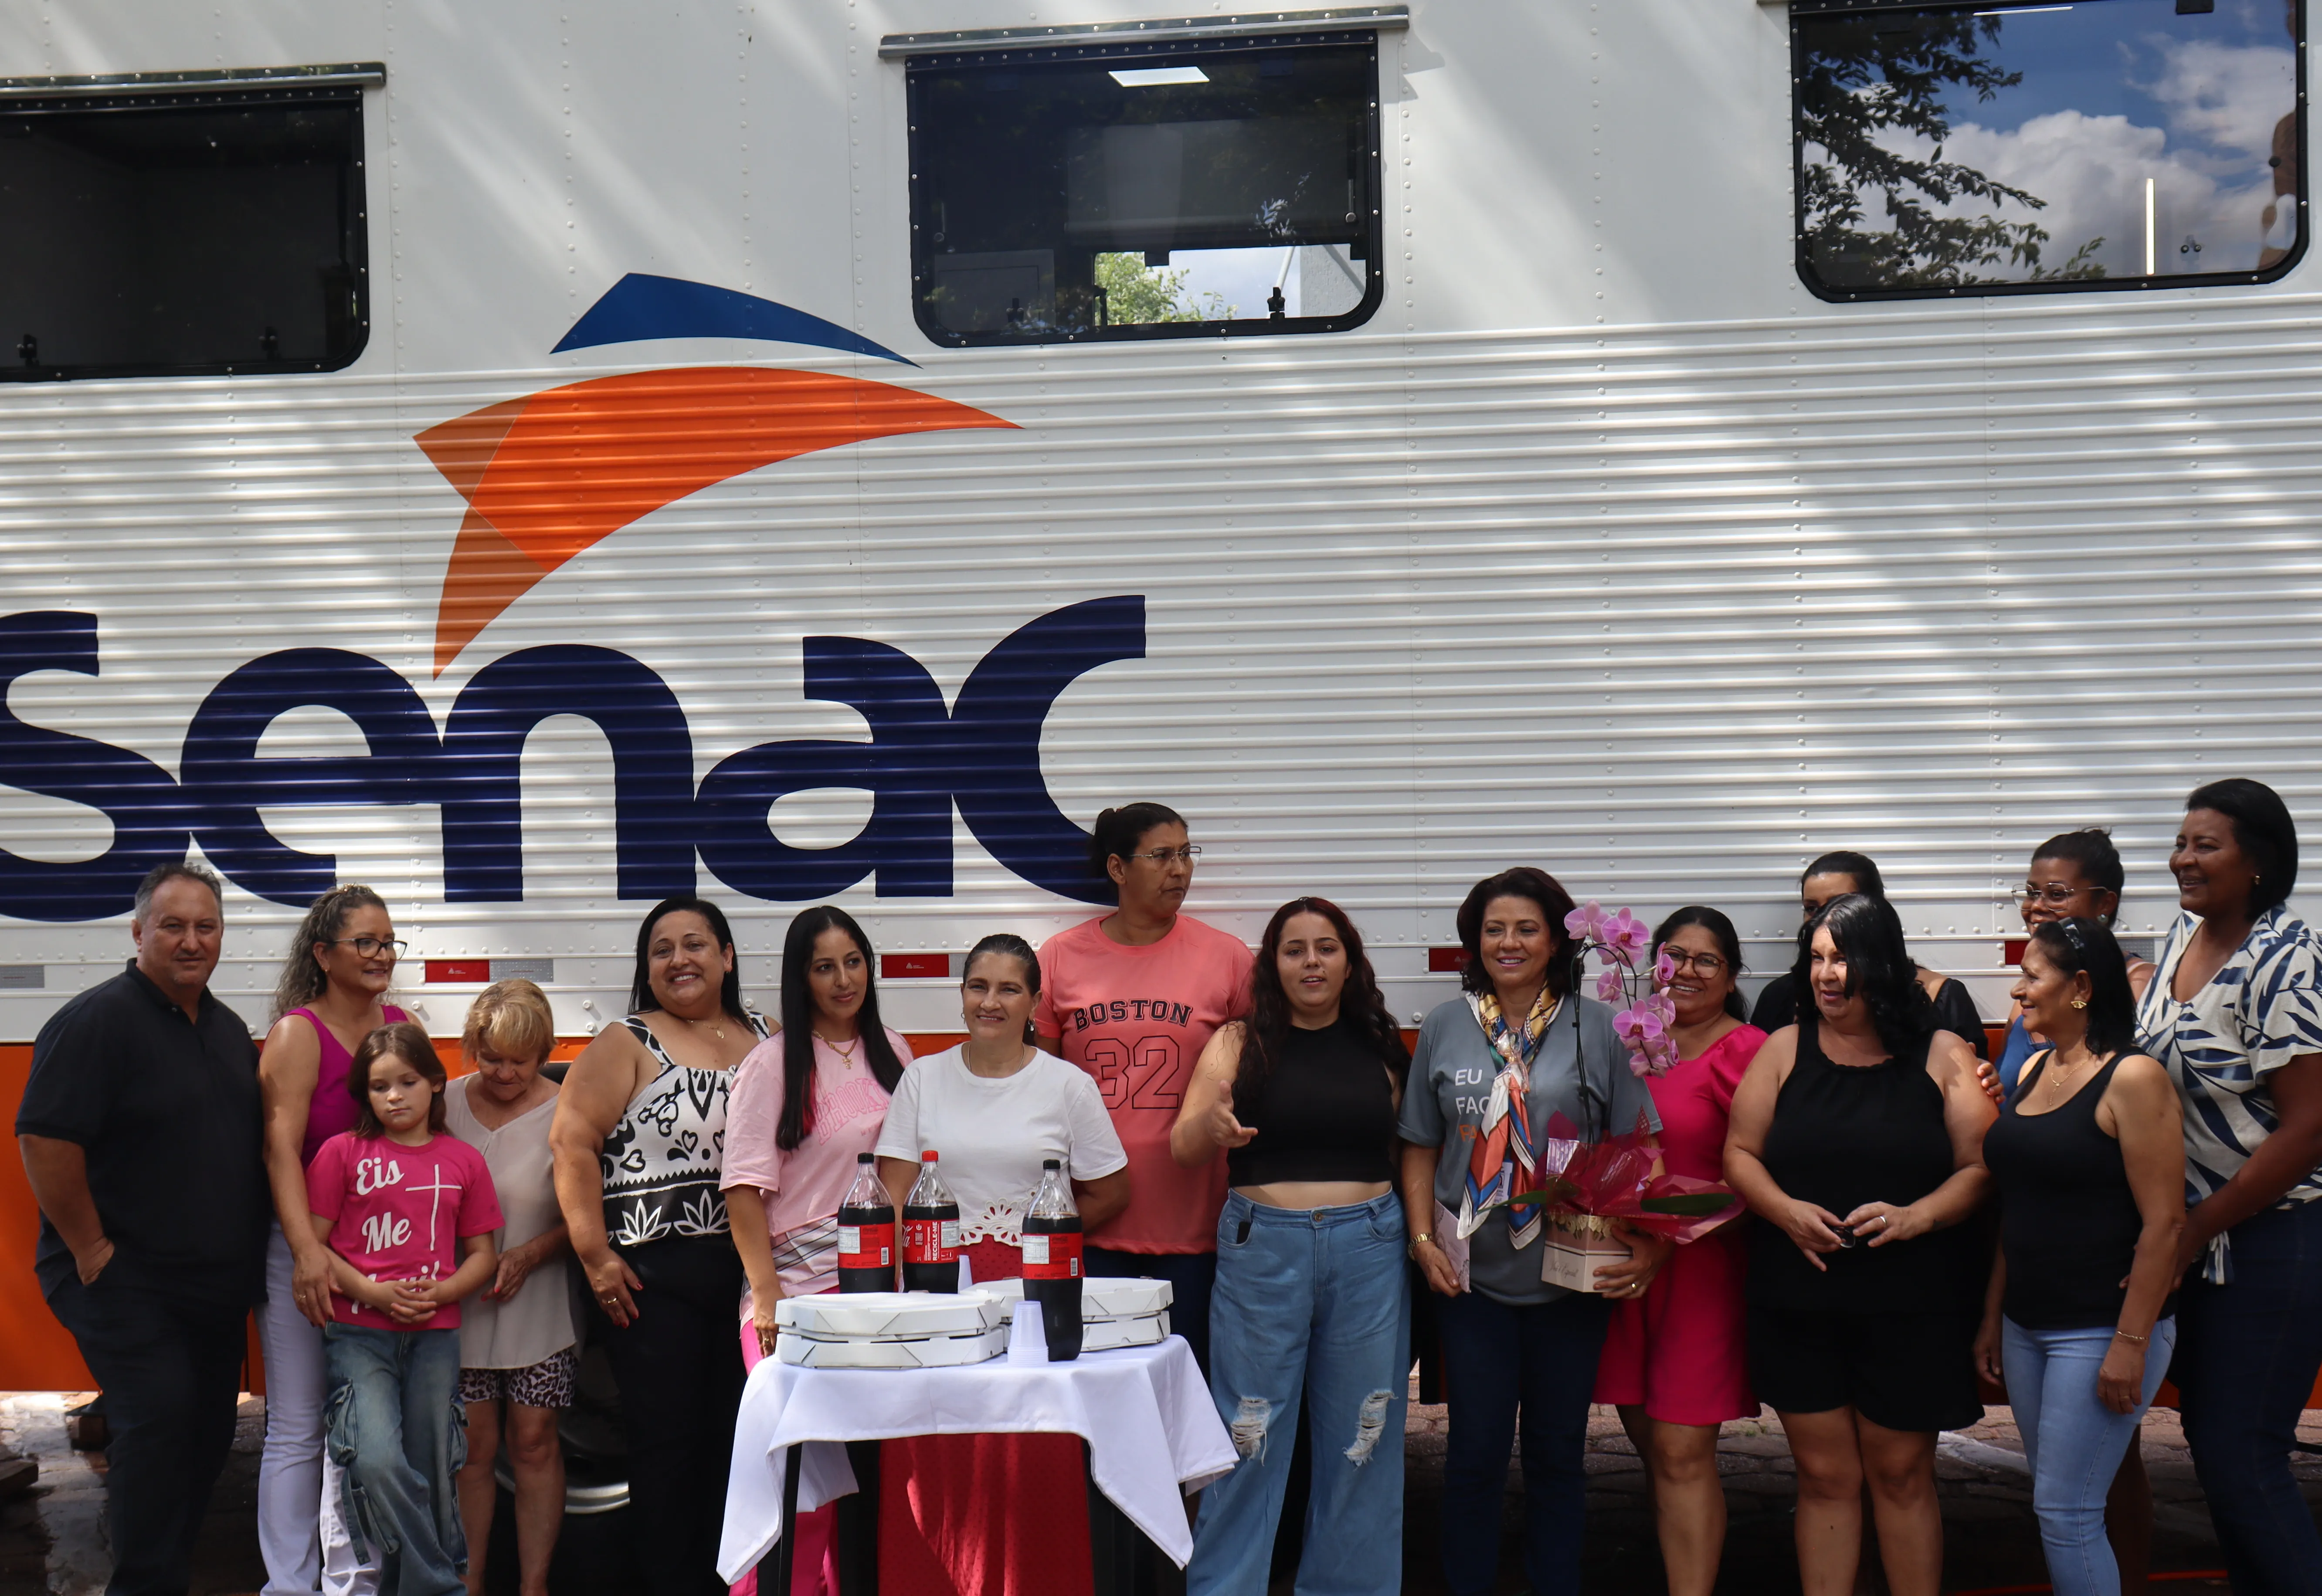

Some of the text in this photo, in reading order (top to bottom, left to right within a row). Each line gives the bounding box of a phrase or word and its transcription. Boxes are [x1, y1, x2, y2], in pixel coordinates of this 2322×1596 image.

[1073, 999, 1193, 1033] BOSTON
[1084, 1035, 1180, 1109] 32
[1455, 1068, 1483, 1086] EU
[1455, 1096, 1491, 1116] FAC
[356, 1157, 405, 1196] Eis
[361, 1211, 412, 1254] Me
